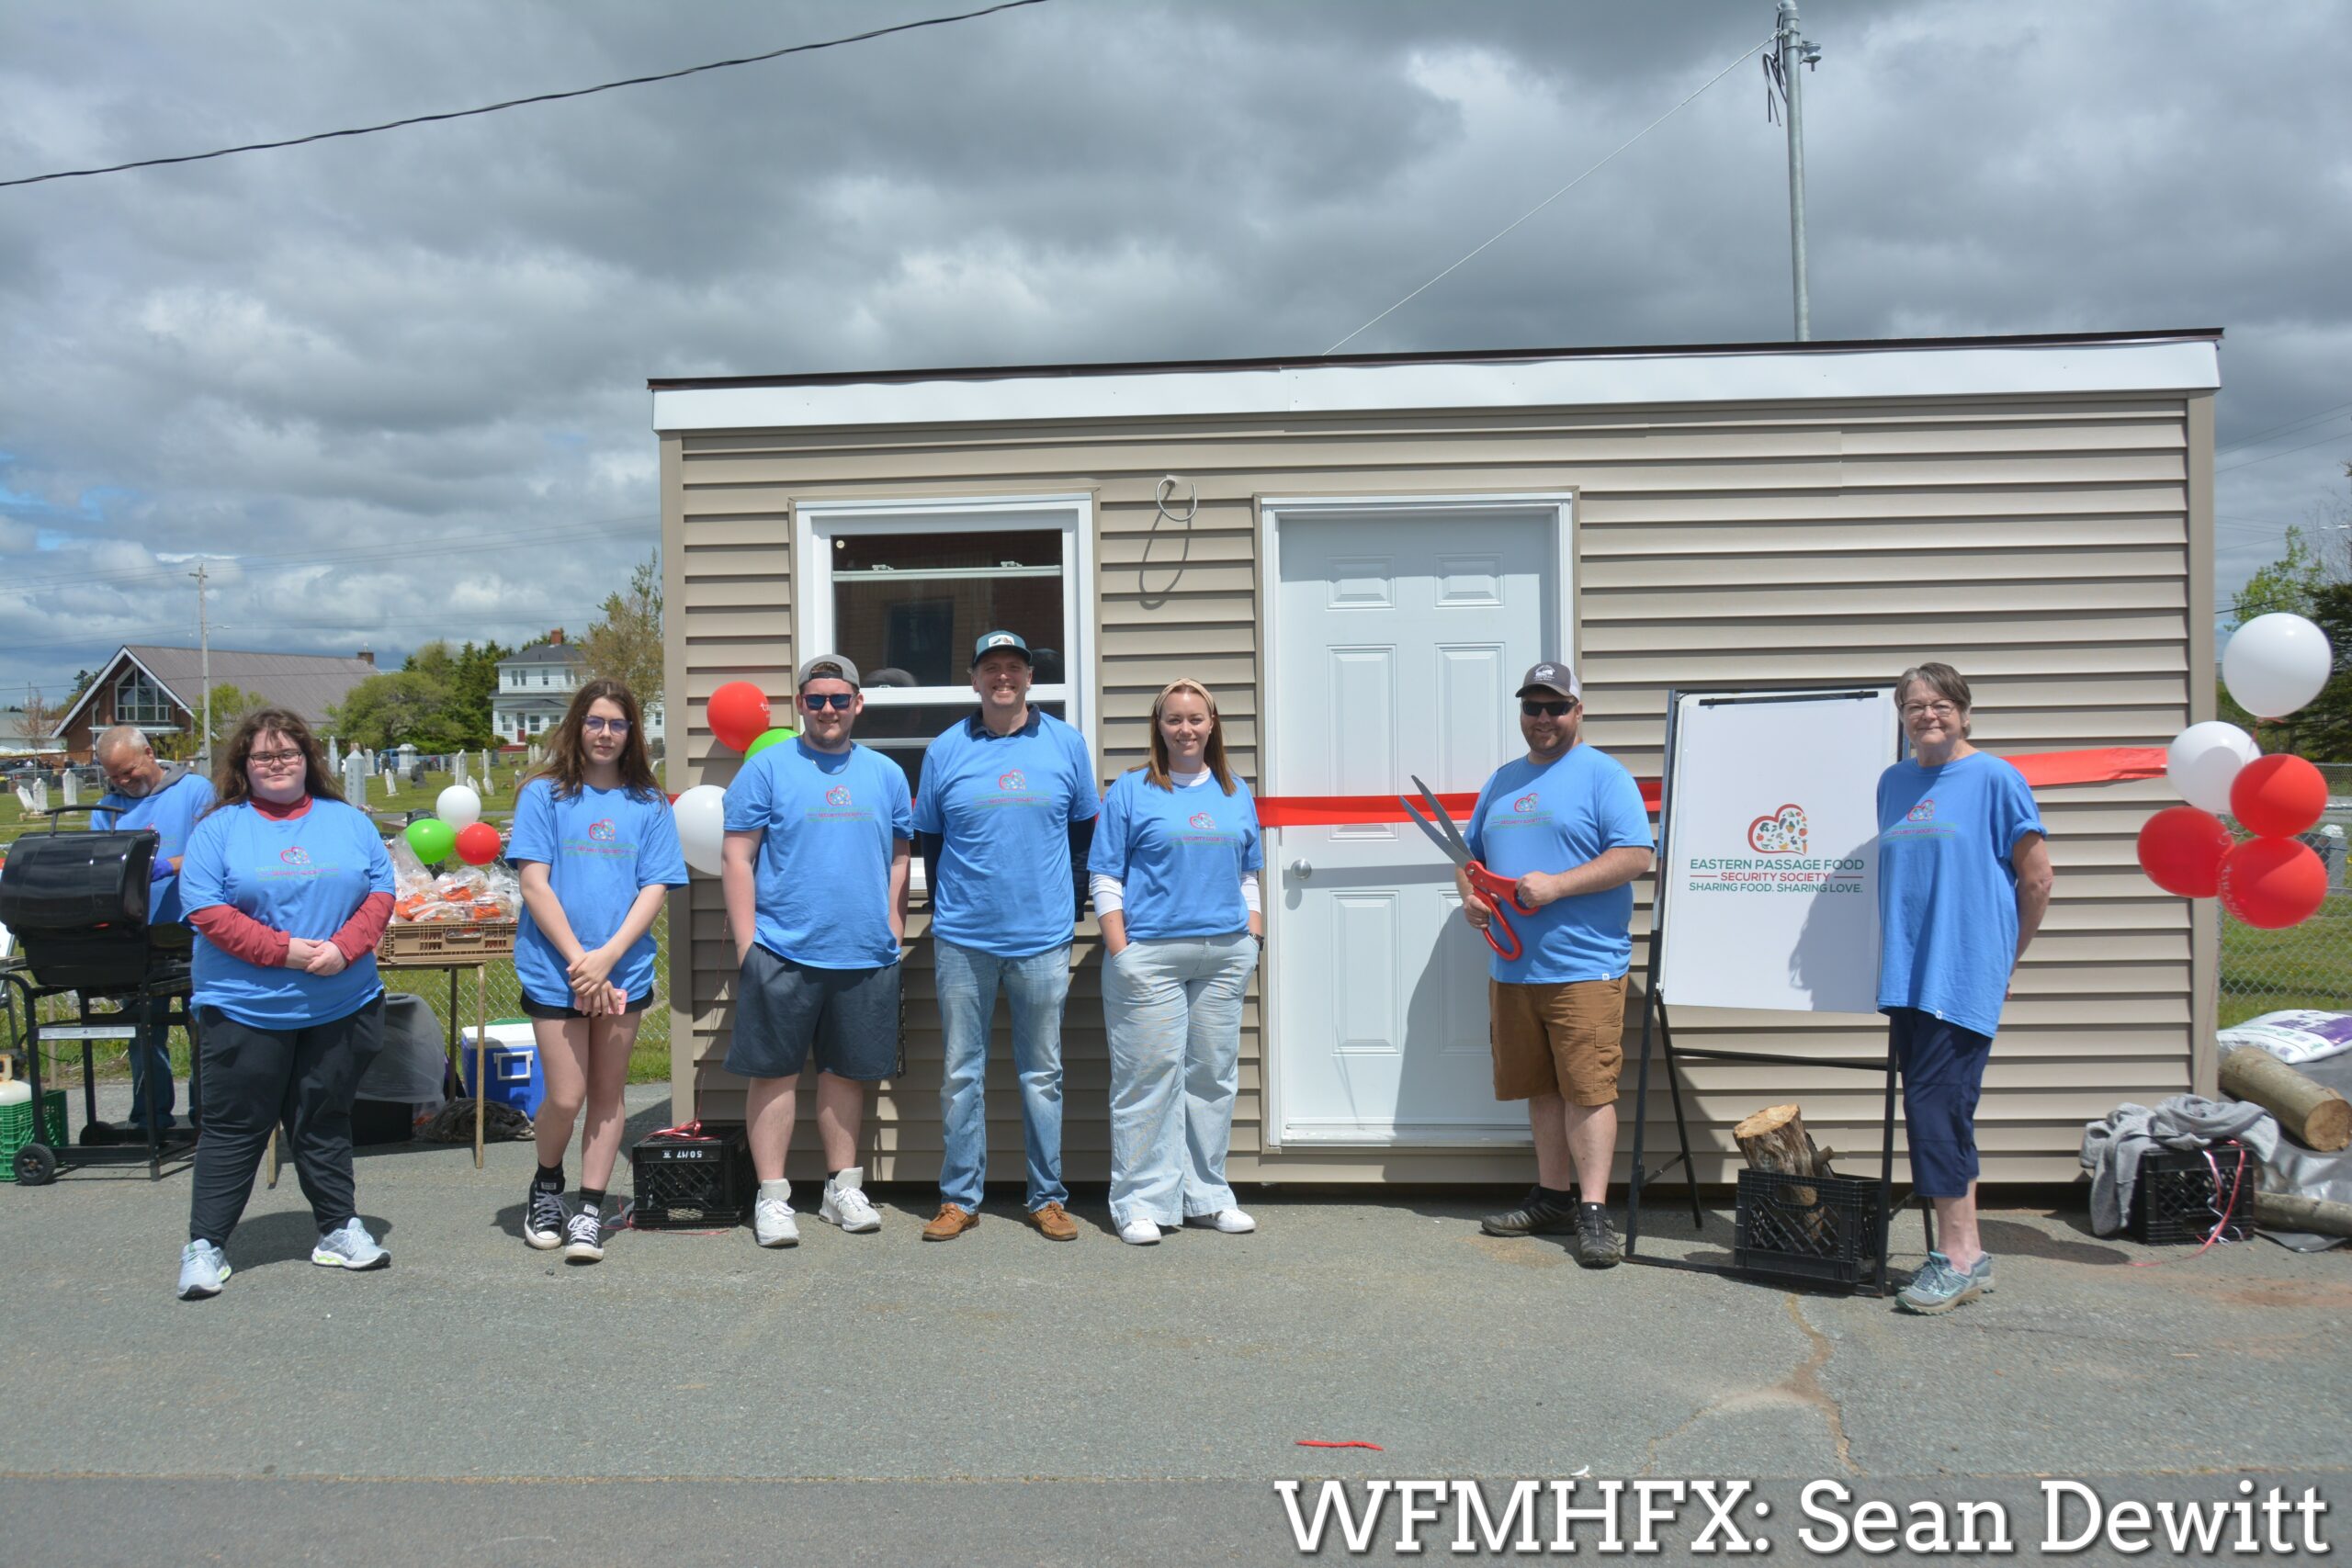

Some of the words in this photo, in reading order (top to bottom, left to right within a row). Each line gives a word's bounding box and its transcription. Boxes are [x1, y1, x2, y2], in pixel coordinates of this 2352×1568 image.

[1690, 858, 1752, 870] EASTERN
[1755, 859, 1821, 870] PASSAGE
[1824, 859, 1864, 870] FOOD
[1720, 872, 1777, 882] SECURITY
[1779, 872, 1831, 882] SOCIETY
[1689, 882, 1738, 891] SHARING
[1740, 883, 1775, 892] FOOD.
[1776, 883, 1828, 893] SHARING
[1829, 884, 1863, 893] LOVE.
